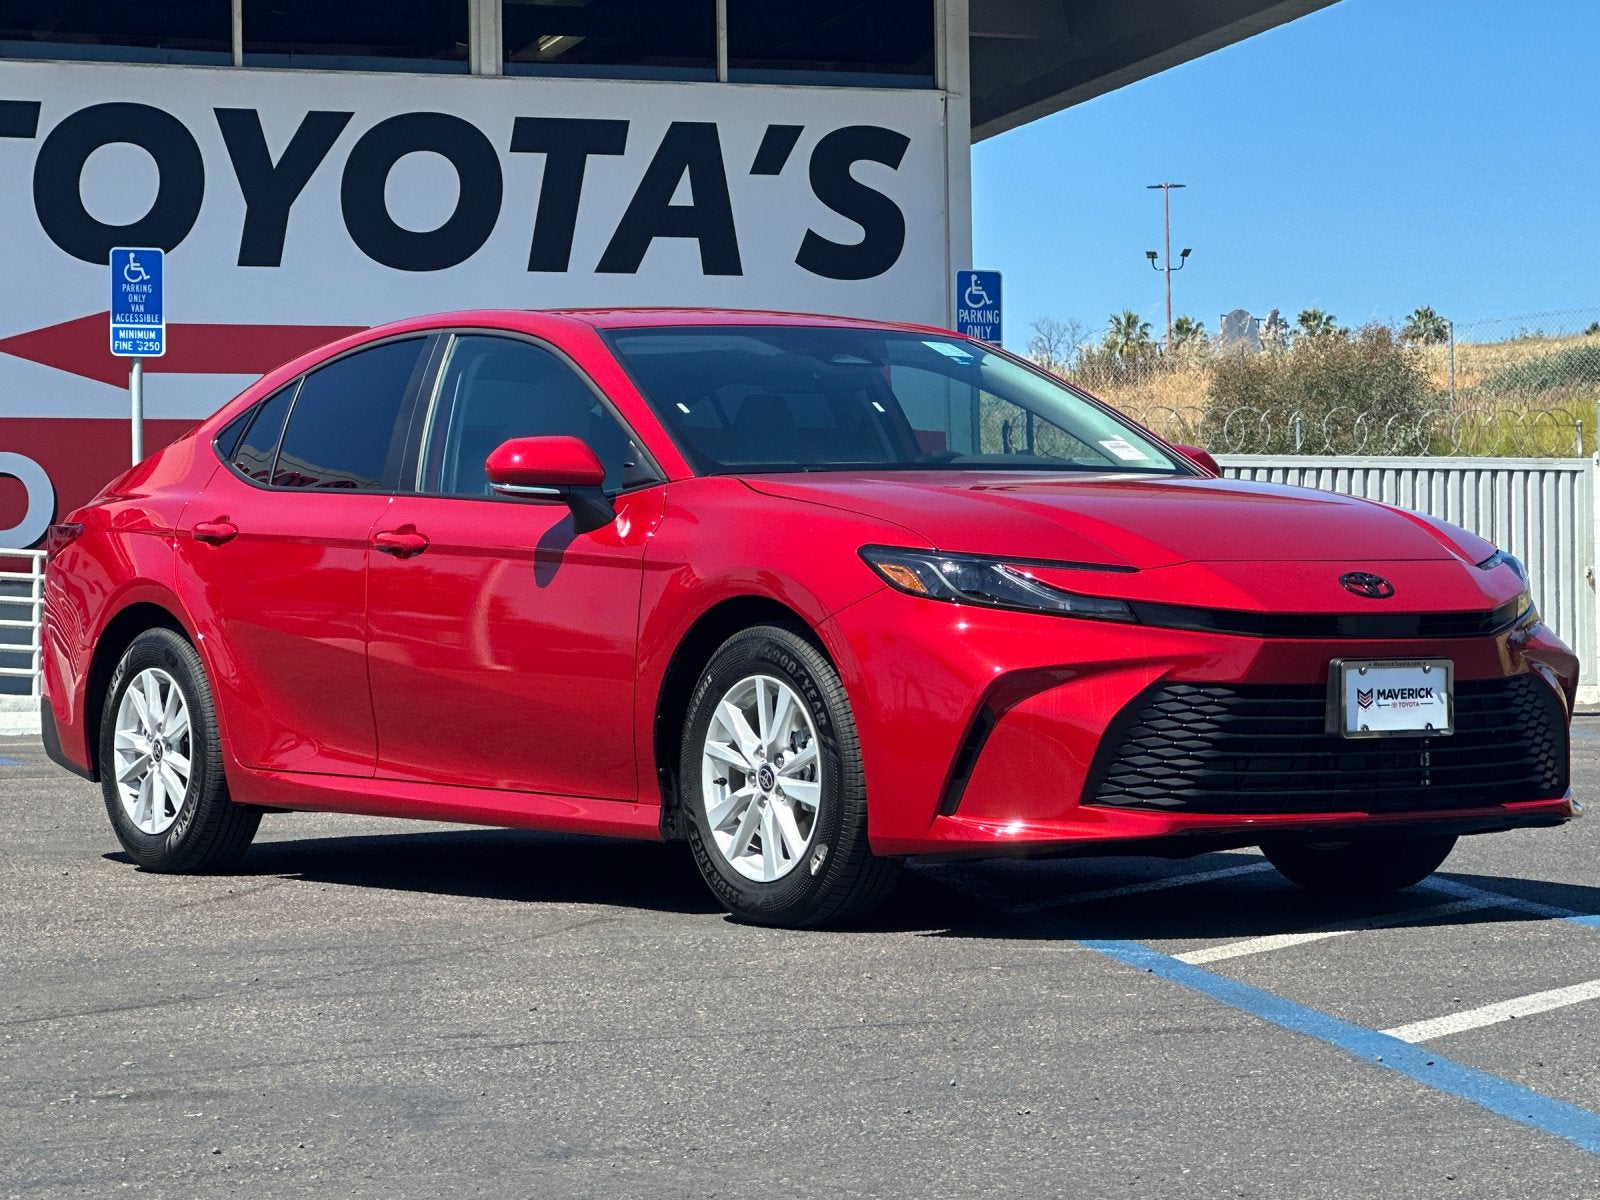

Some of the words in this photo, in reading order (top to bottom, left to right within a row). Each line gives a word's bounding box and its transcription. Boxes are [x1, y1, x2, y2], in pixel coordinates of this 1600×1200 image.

[122, 284, 152, 293] PARKING
[128, 294, 146, 302] ONLY
[131, 304, 144, 312] VAN
[116, 313, 159, 323] ACCESSIBLE
[959, 309, 999, 323] PARKING
[119, 329, 156, 339] MINIMUM
[967, 325, 991, 339] ONLY
[114, 341, 133, 351] FINE
[136, 340, 160, 351] $250
[1377, 687, 1434, 699] MAVERICK
